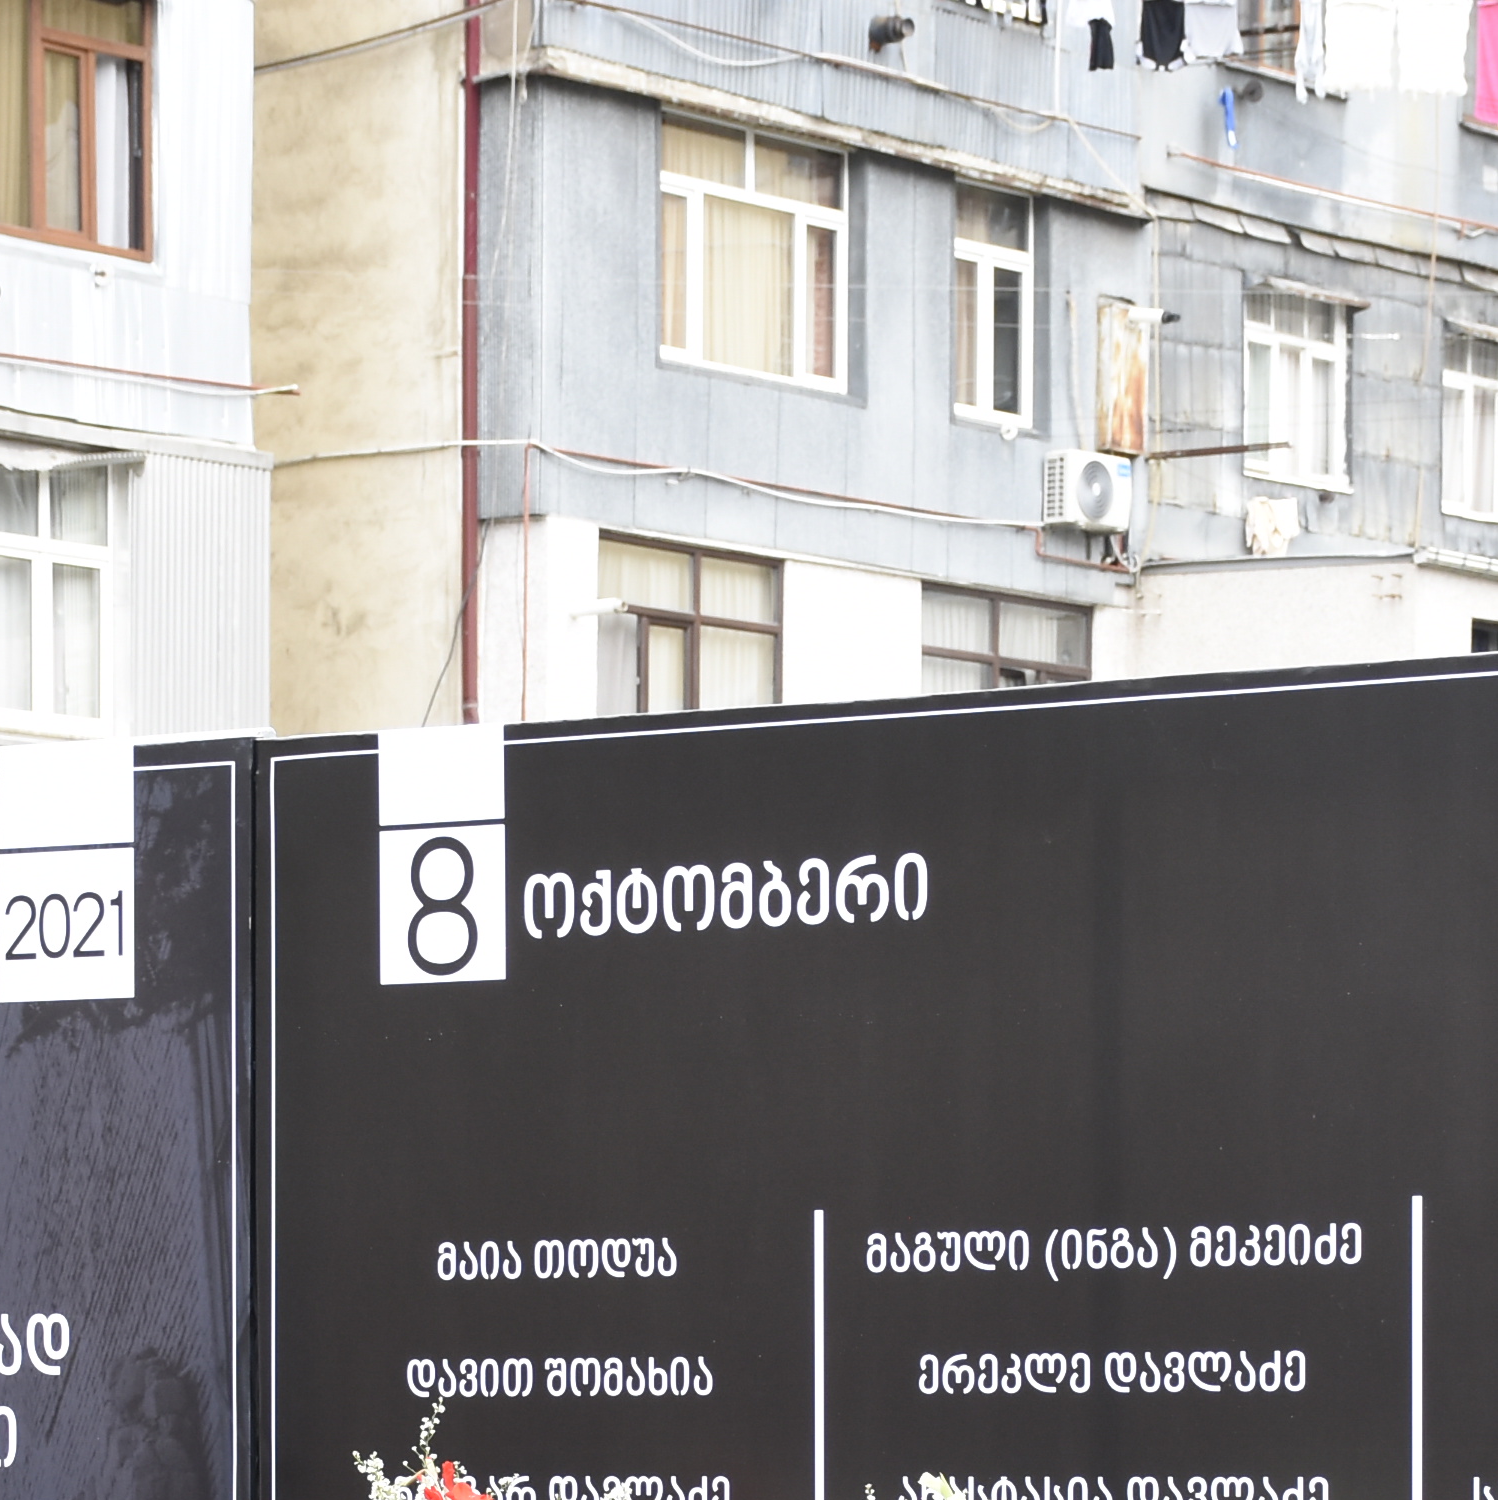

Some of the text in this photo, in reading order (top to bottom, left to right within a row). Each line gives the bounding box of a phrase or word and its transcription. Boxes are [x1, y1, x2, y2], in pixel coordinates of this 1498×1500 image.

[5, 890, 123, 961] 2021
[407, 836, 928, 976] 8 ოქტომბერი
[437, 1237, 677, 1281] მაია თოდუა
[866, 1222, 1362, 1282] მაგული (ინგა) მეკეიძე
[406, 1355, 713, 1398] დავით შომახია
[918, 1349, 1306, 1395] ერეკლე დავლაძე
